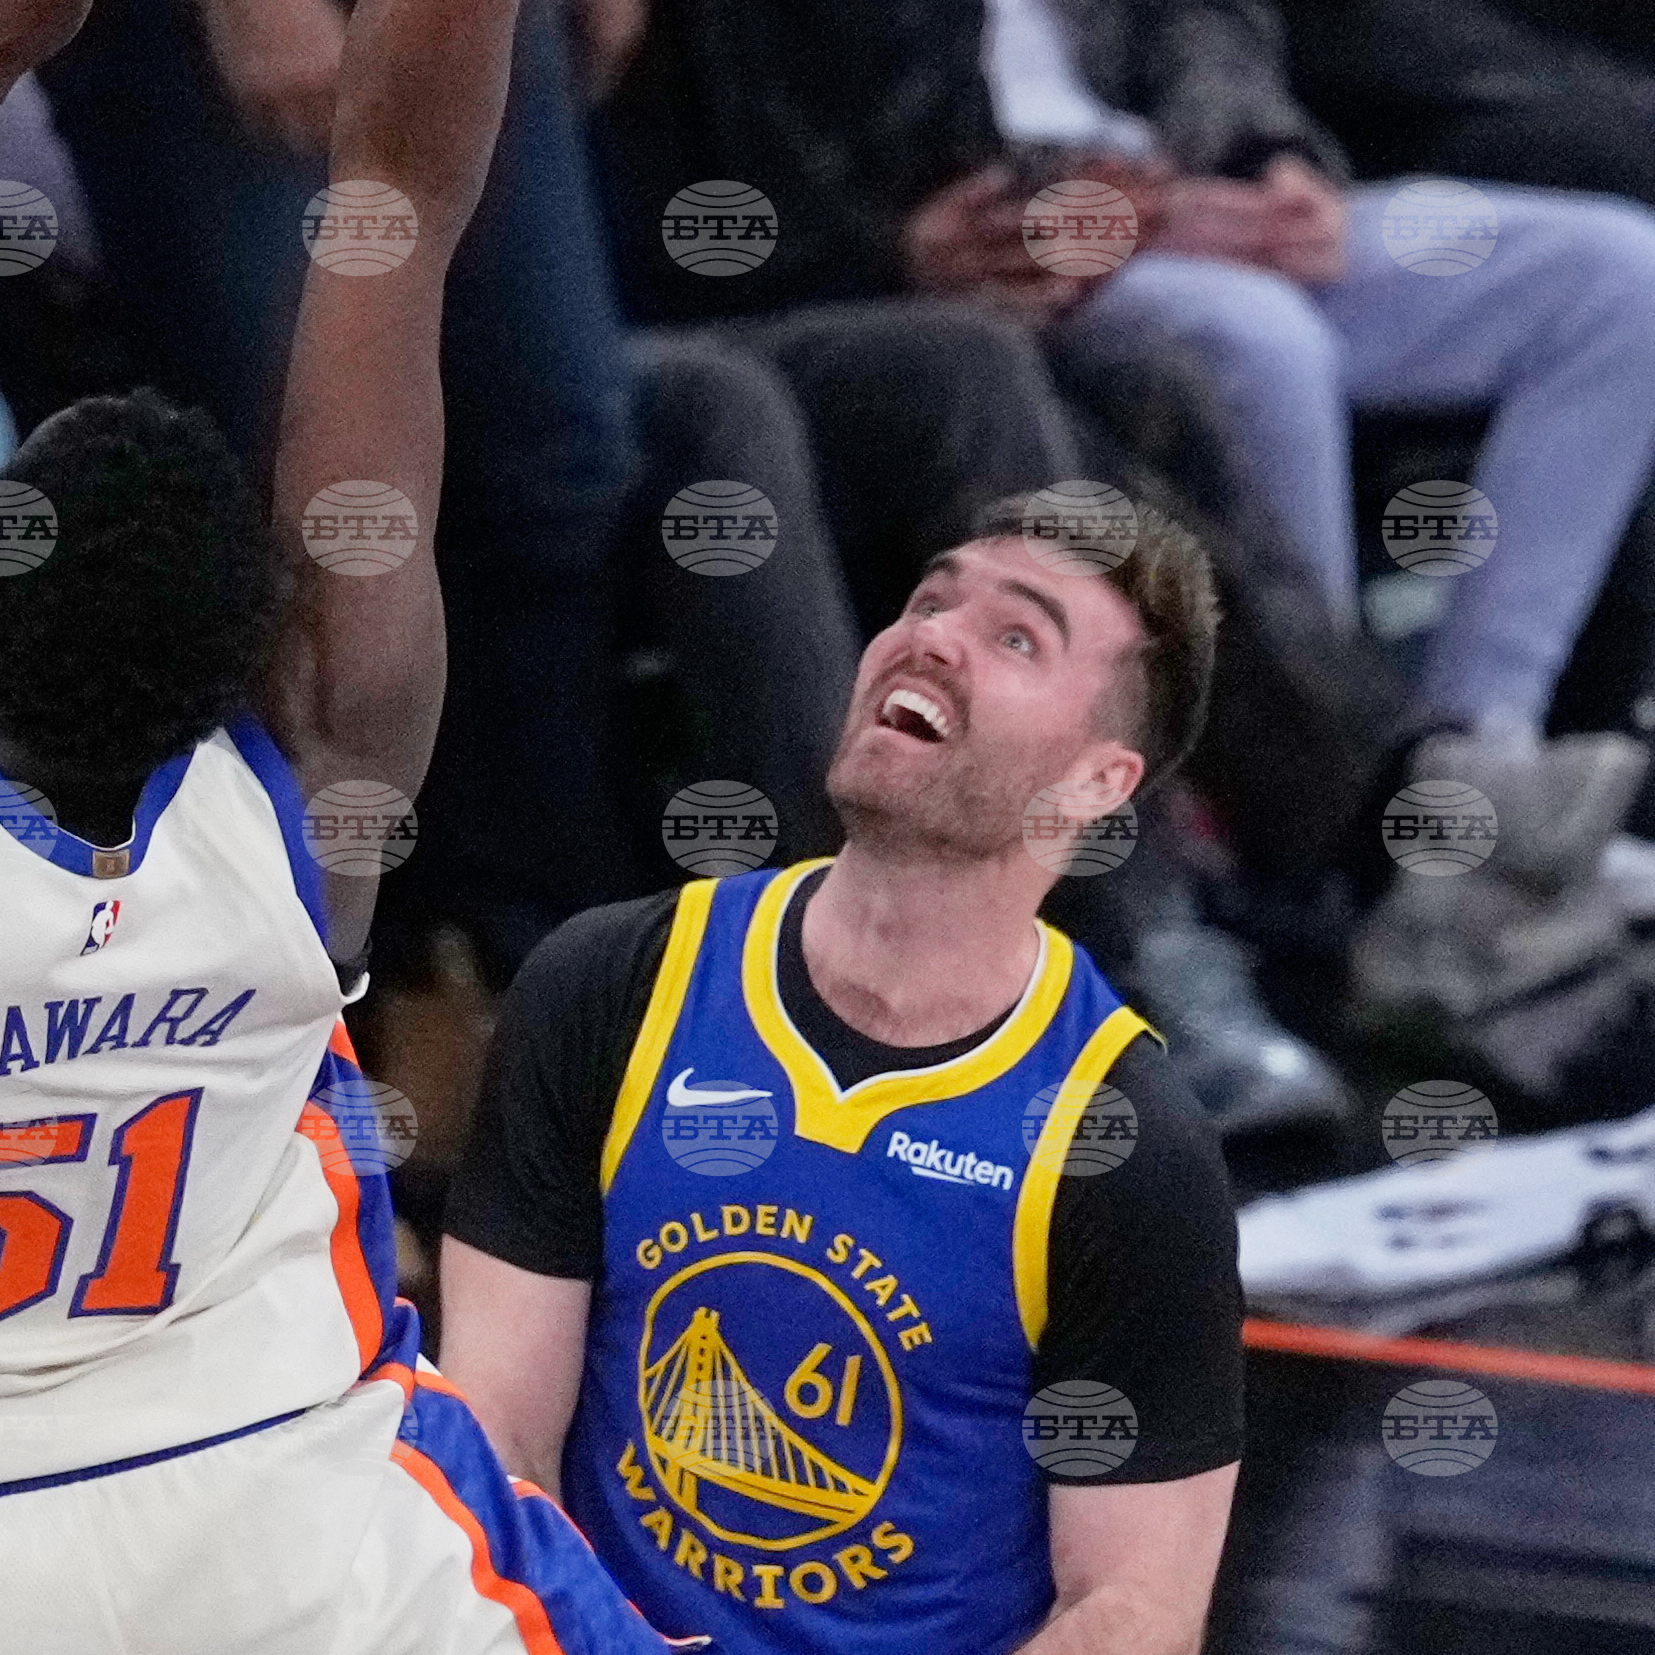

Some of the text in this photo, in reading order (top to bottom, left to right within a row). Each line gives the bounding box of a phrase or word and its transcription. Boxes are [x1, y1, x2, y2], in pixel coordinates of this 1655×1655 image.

[886, 1131, 1014, 1191] Rakuten
[636, 1204, 934, 1352] GOLDEN STATE
[783, 1342, 863, 1427] 61
[616, 1438, 916, 1611] WARRIORS
